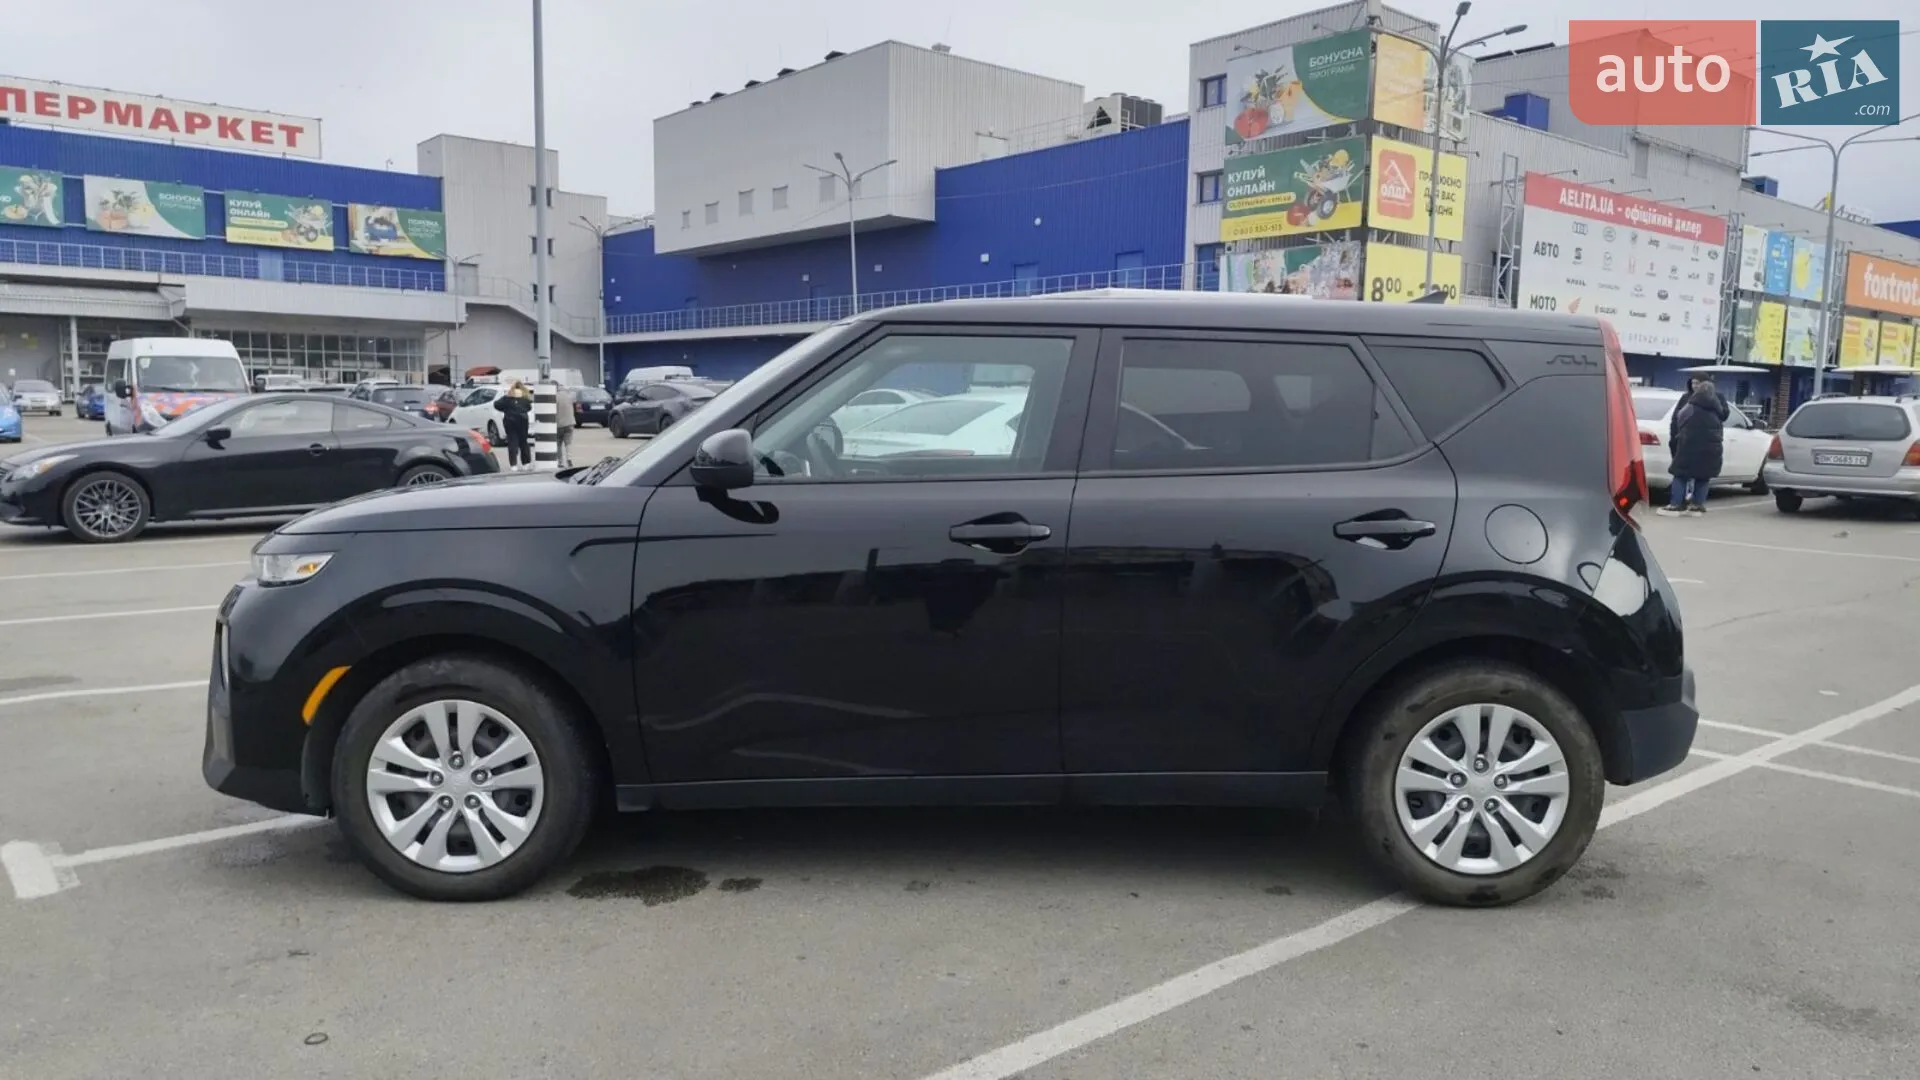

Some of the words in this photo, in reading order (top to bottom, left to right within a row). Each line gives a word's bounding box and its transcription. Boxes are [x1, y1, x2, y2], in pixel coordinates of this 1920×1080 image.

[1308, 46, 1365, 68] БОНУСНА
[0, 86, 304, 148] ПЕРМАРКЕТ
[1228, 165, 1266, 184] КУПУЙ
[1227, 180, 1276, 197] ОНЛАЙН
[229, 199, 262, 209] КУПУЙ
[1559, 188, 1615, 216] AELITA.UA
[1624, 204, 1673, 228] офіційний
[1674, 218, 1702, 237] дилер
[229, 207, 271, 219] ОНЛАЙН
[1533, 241, 1560, 258] АВТО
[1529, 294, 1557, 311] МОТО
